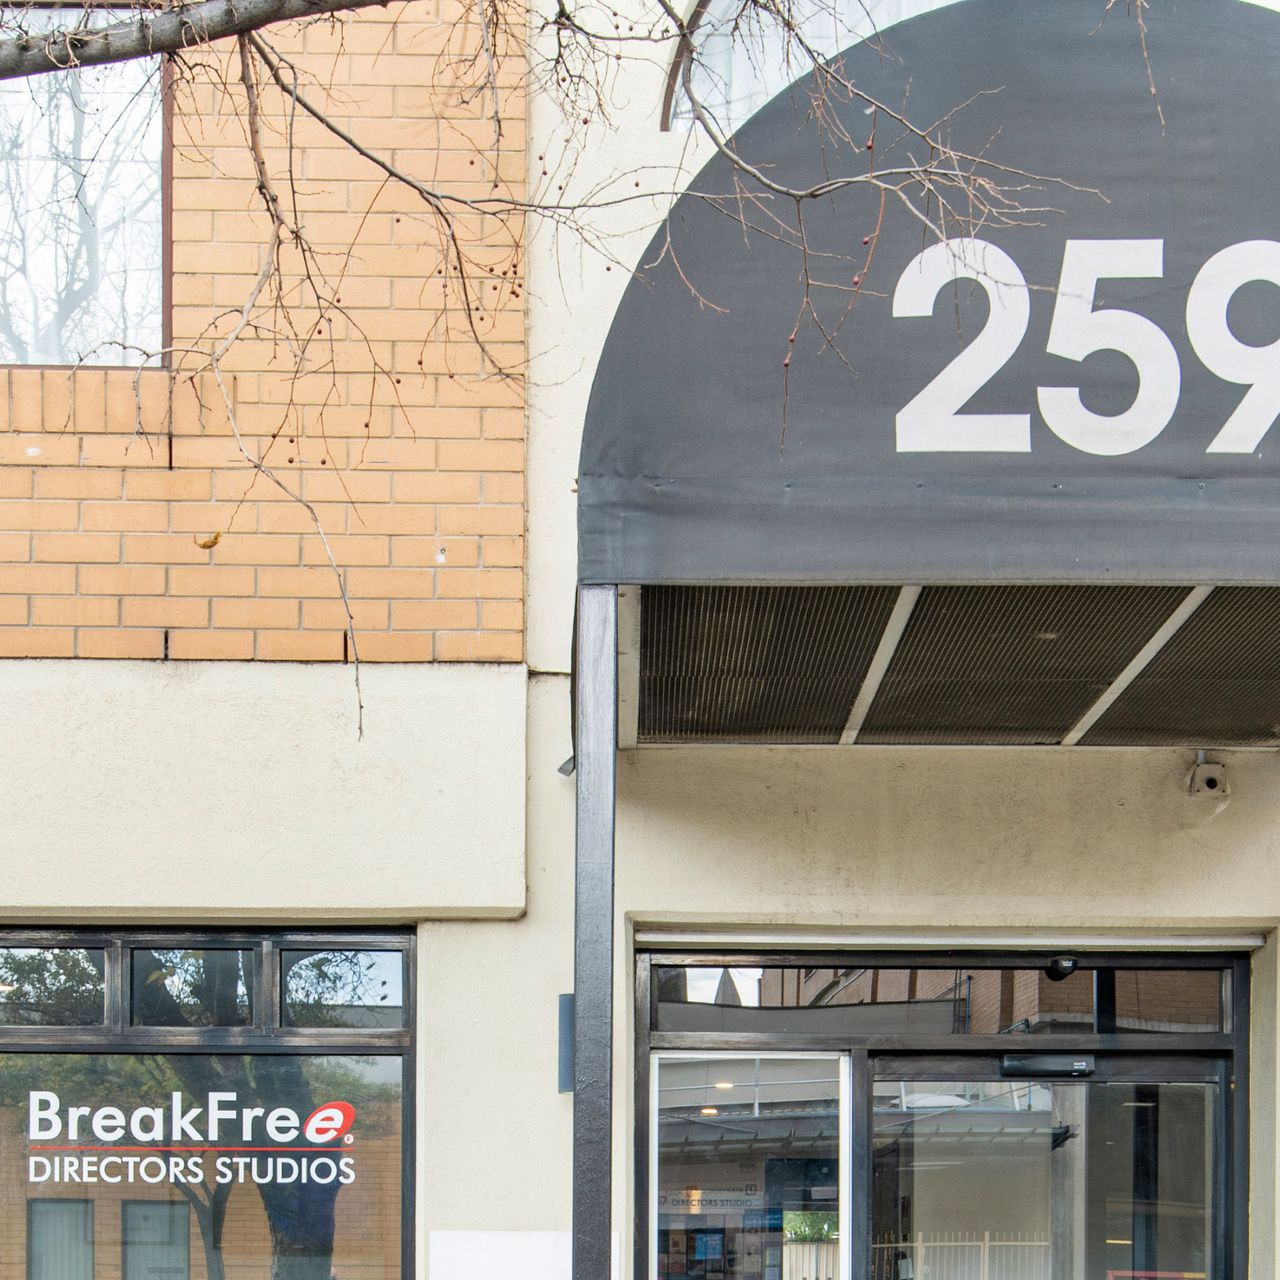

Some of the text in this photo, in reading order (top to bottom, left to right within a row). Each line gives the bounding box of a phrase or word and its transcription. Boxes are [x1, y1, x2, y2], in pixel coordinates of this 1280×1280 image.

[28, 1090, 356, 1144] BreakFree
[28, 1156, 356, 1184] DIRECTORS STUDIOS
